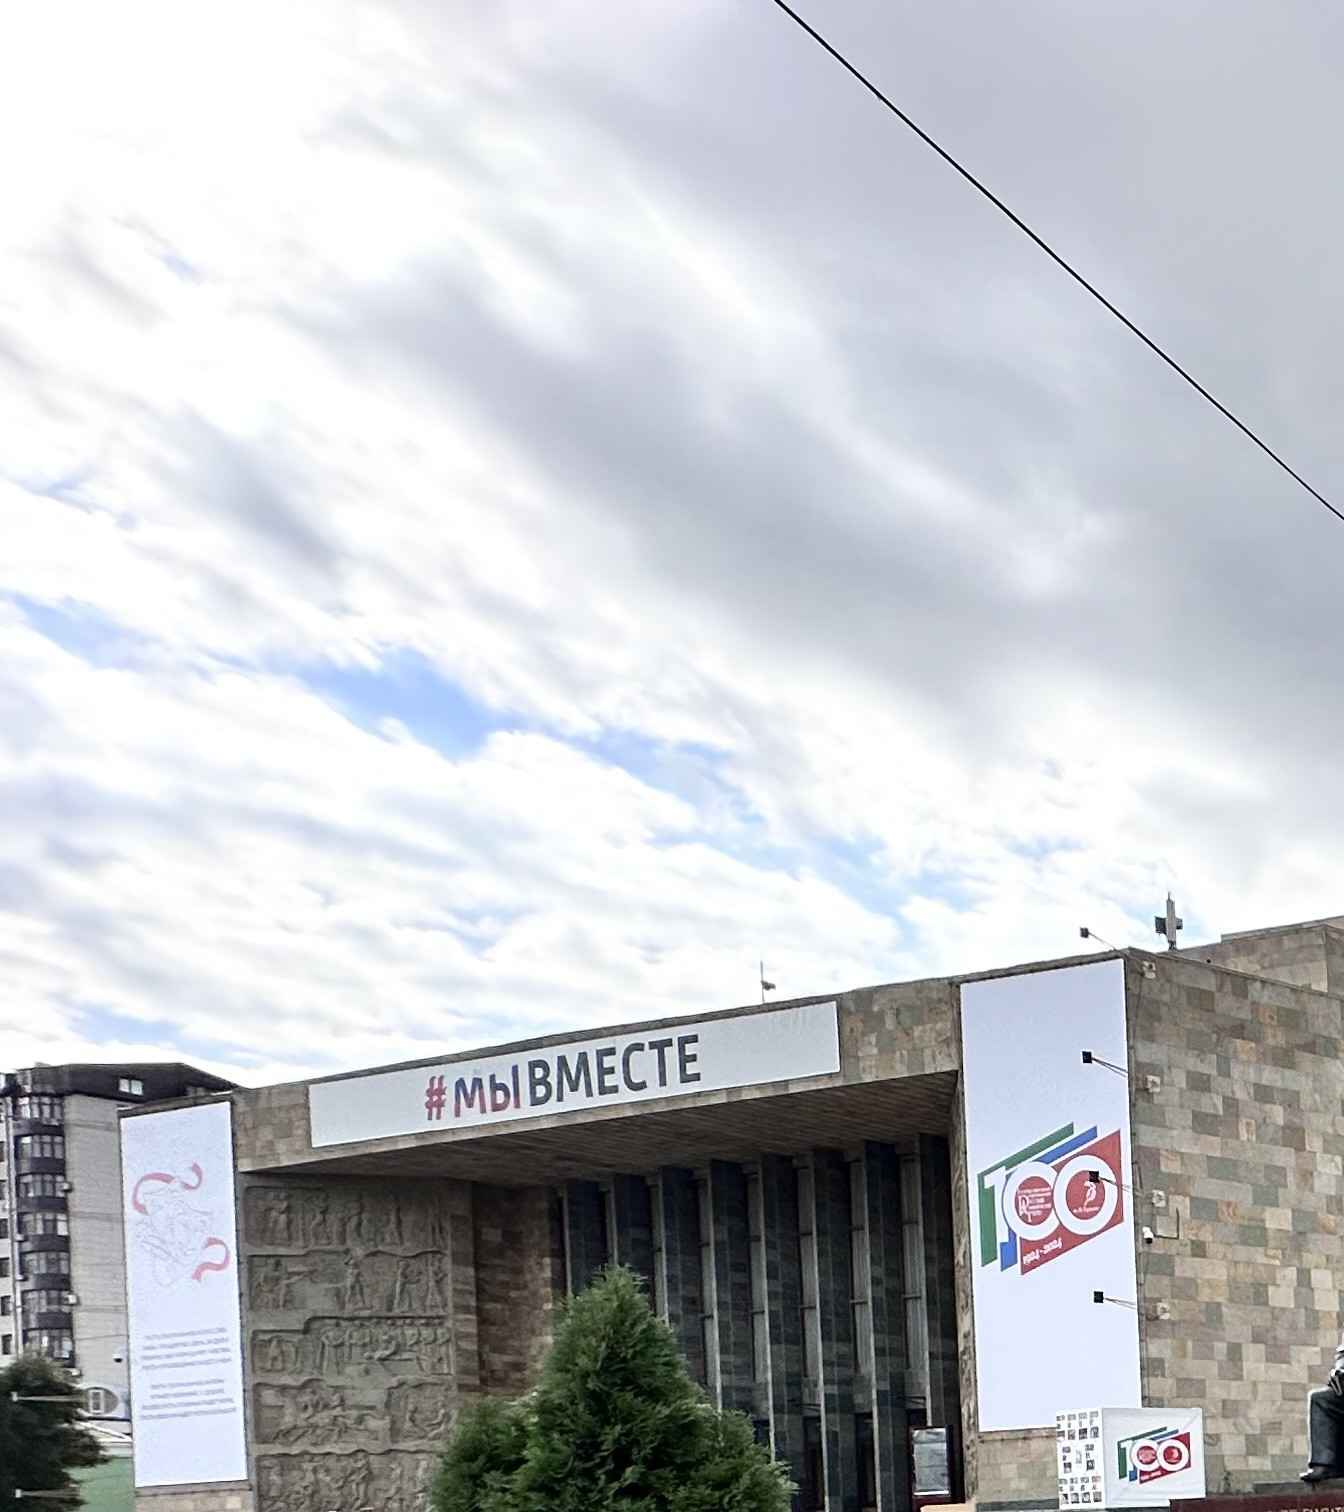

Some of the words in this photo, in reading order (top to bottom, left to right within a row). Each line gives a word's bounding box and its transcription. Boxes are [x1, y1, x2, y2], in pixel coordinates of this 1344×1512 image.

[425, 1033, 701, 1121] #МЫВМЕСТЕ
[984, 1155, 1118, 1243] 100
[1120, 1438, 1190, 1472] 100
